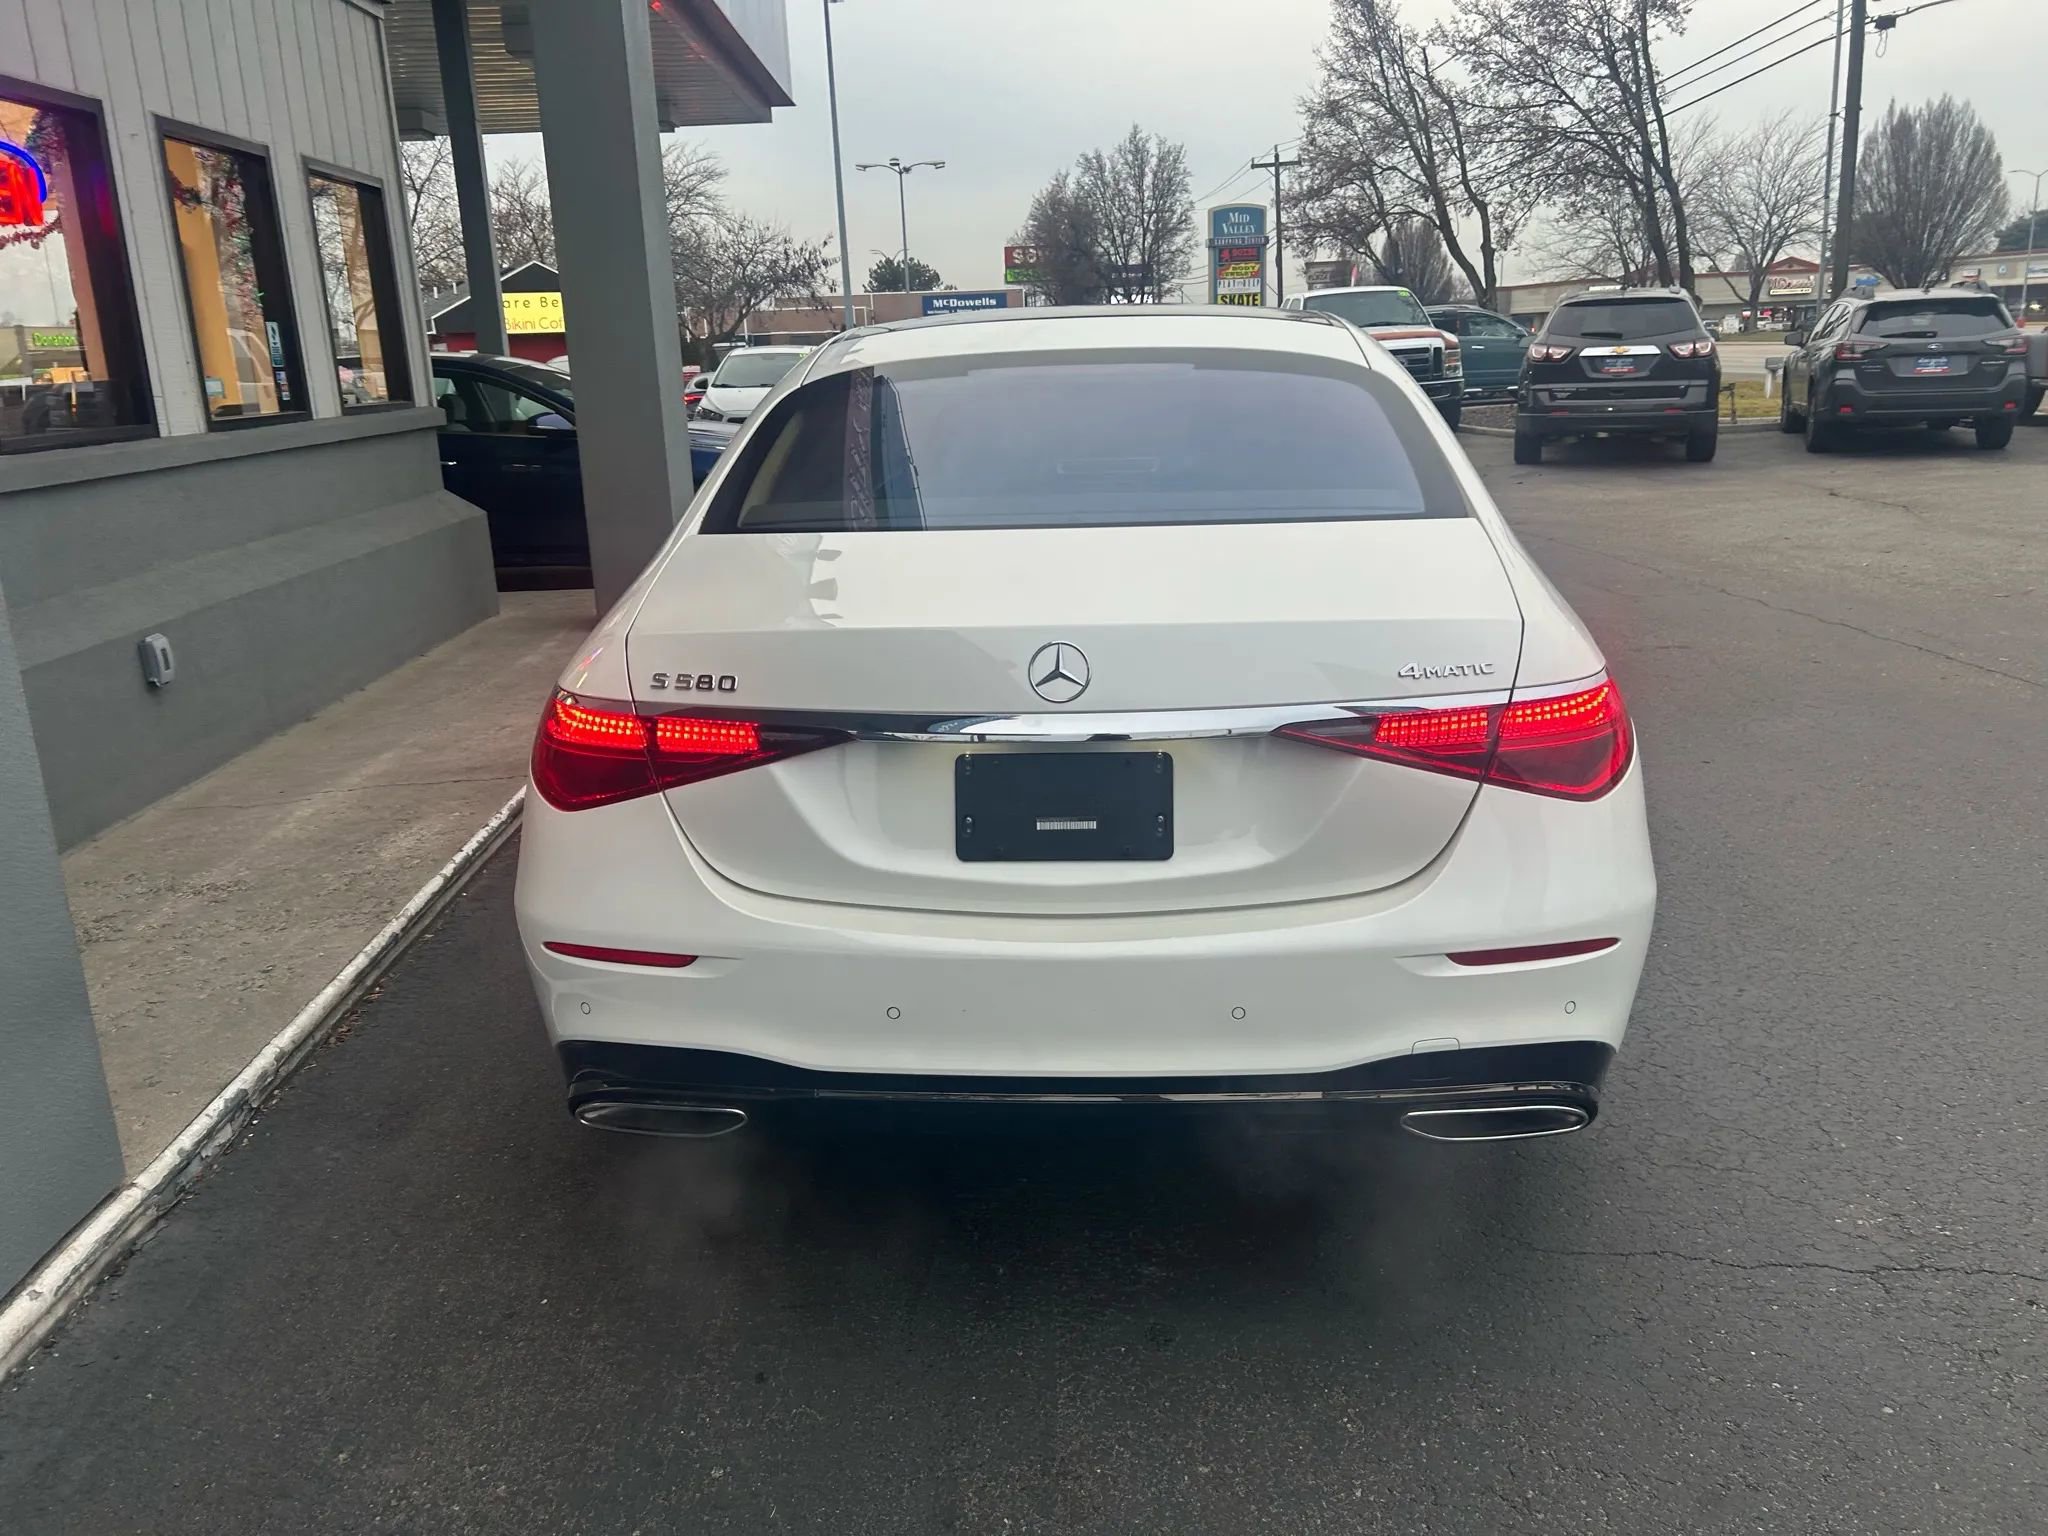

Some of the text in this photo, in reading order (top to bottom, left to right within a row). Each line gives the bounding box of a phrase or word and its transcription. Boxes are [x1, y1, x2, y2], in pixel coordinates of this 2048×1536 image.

[1222, 223, 1257, 235] VALLEY
[932, 297, 997, 308] McDowells
[1220, 292, 1260, 307] SKATE
[504, 317, 536, 331] Bikini
[1398, 662, 1496, 680] 4MATIC
[649, 672, 739, 692] S 580
